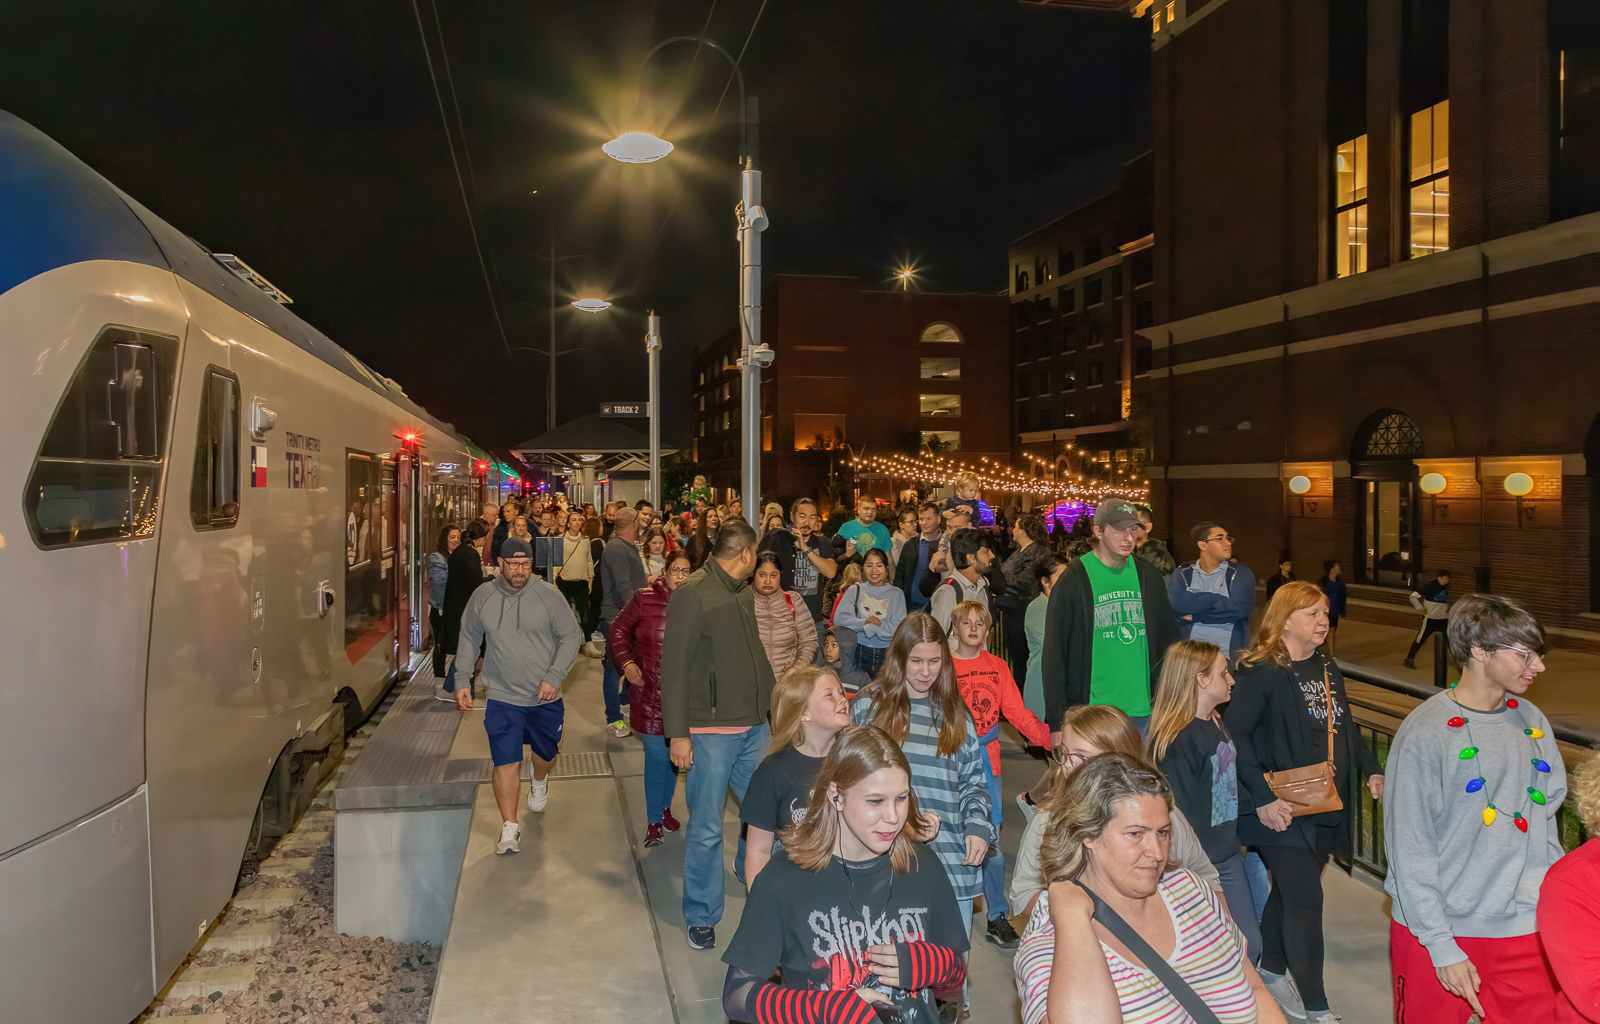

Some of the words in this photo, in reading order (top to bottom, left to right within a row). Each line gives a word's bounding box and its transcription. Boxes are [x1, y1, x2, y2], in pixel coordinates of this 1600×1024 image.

[613, 405, 634, 413] TRACK
[635, 405, 639, 413] 2
[1097, 590, 1135, 603] UNIVERSITY
[1094, 602, 1122, 629] NORTH
